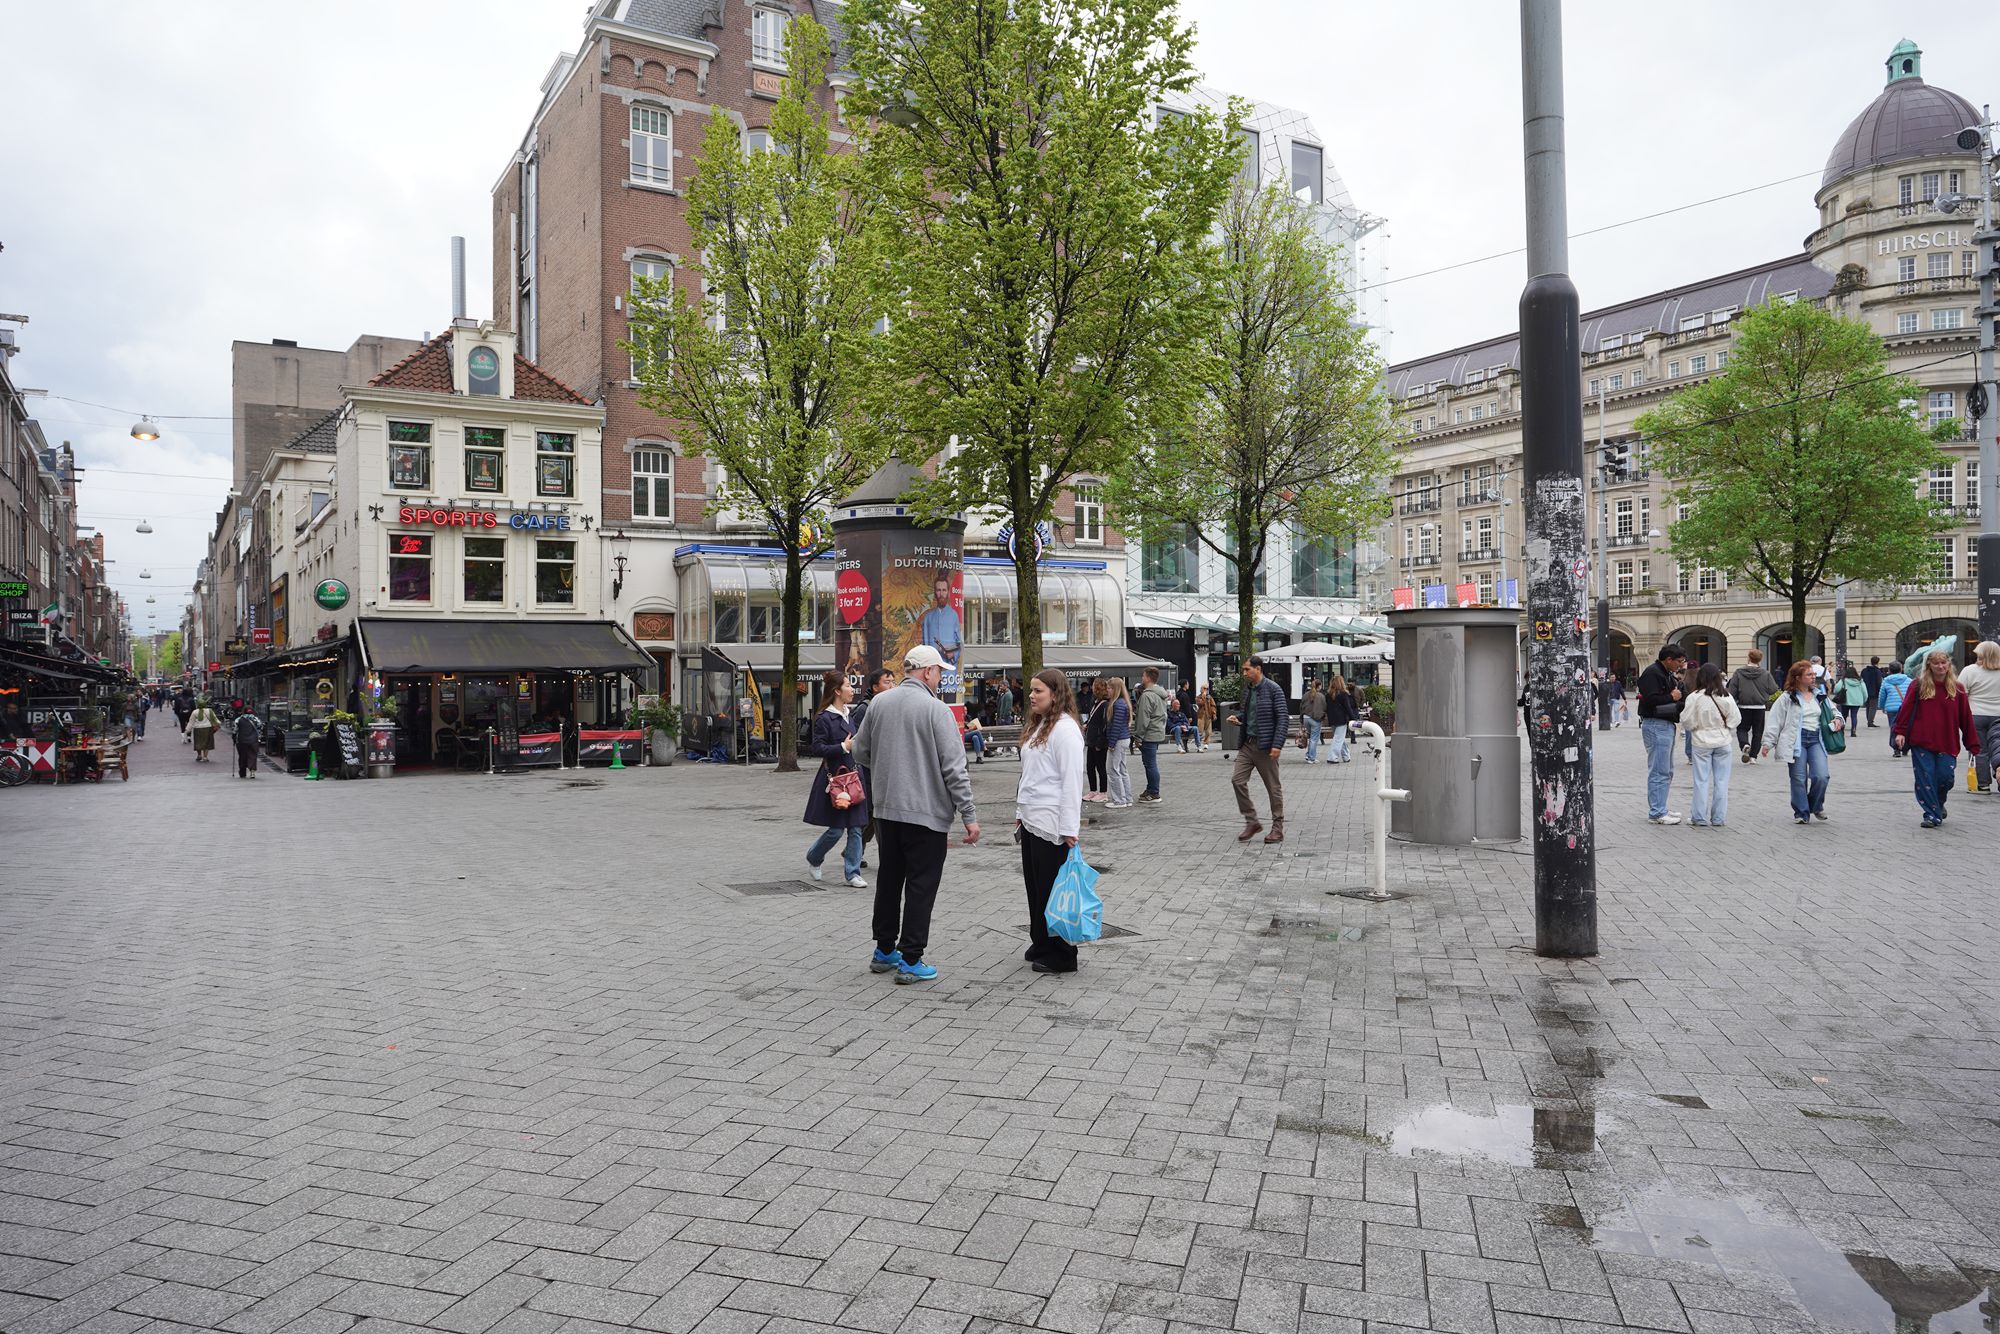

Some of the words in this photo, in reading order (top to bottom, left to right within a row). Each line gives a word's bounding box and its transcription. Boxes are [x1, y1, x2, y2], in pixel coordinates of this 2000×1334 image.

[760, 78, 780, 90] ANN
[1878, 231, 1960, 256] HIRSCH
[400, 495, 570, 514] SATELLITE
[400, 507, 497, 528] SPORTS
[509, 514, 571, 531] CAFE
[914, 546, 942, 556] MEET
[943, 548, 958, 558] THE
[835, 560, 861, 571] ASTERS
[894, 558, 932, 568] DUTCH
[843, 598, 854, 607] for
[855, 597, 863, 607] 2!
[11, 612, 33, 620] IBIZA
[1135, 629, 1186, 639] BASEMENT
[1065, 670, 1101, 678] COFFEESHOP
